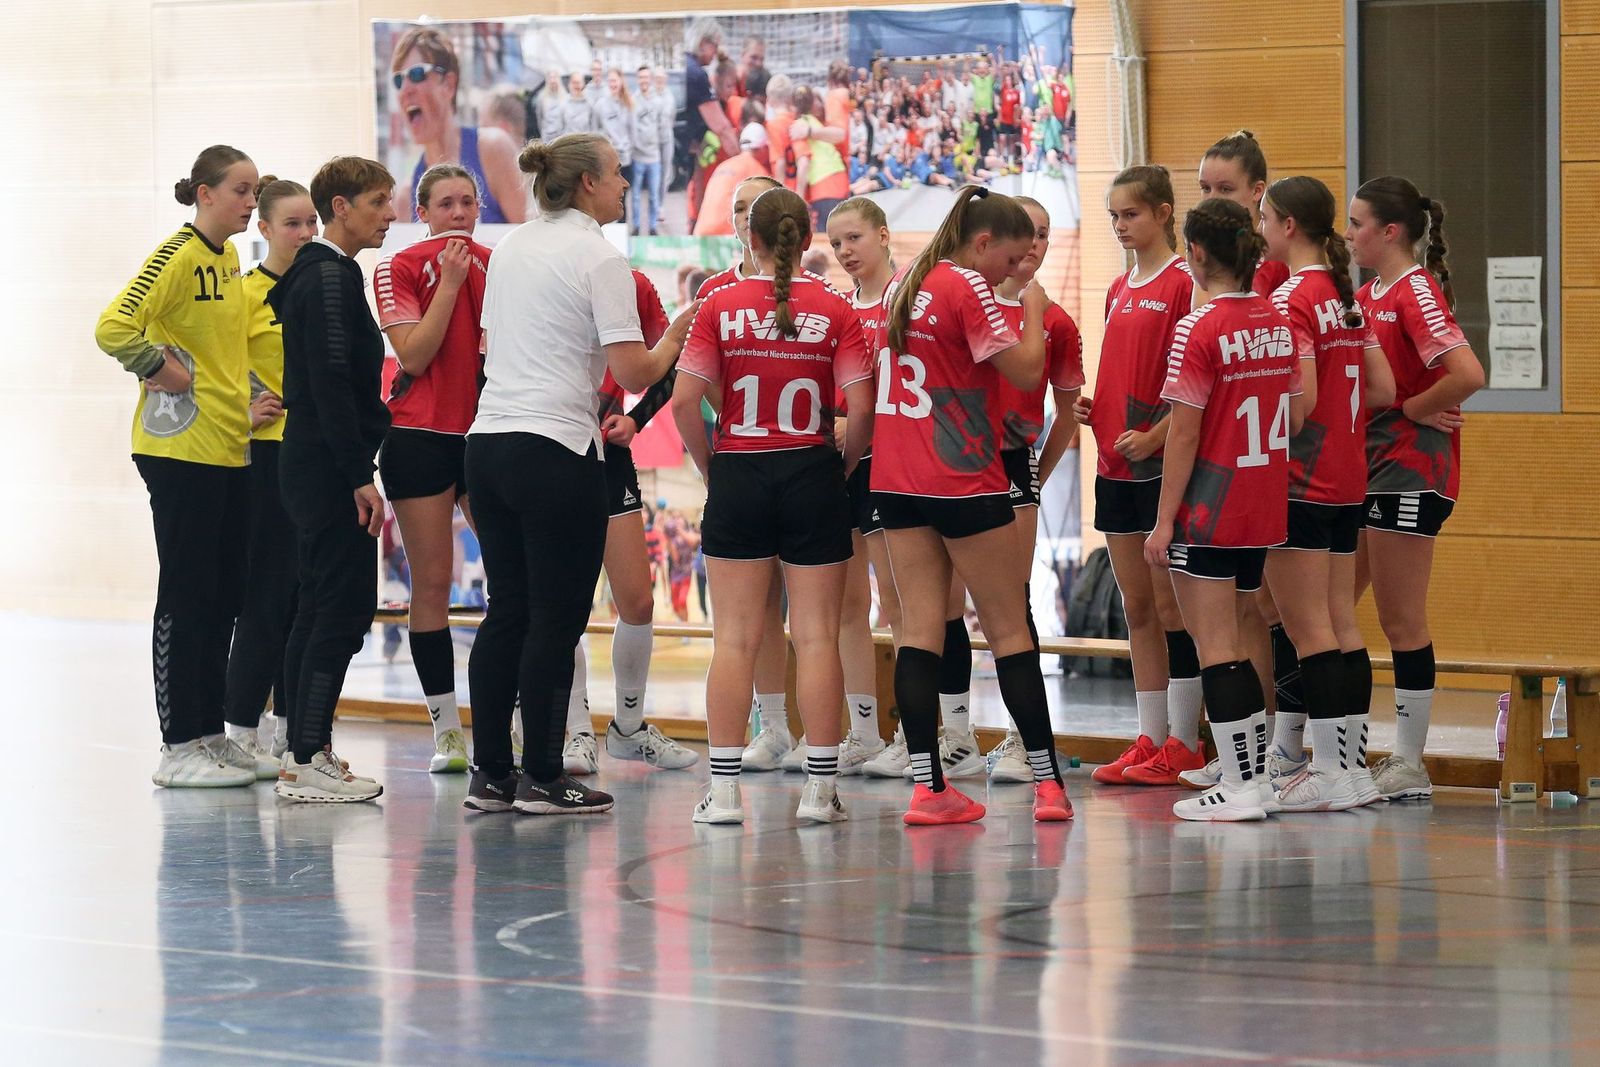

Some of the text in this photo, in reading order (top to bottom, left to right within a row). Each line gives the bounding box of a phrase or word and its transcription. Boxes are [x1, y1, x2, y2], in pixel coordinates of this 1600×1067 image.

[730, 374, 821, 436] 10
[875, 346, 933, 419] 13
[1236, 392, 1290, 468] 14
